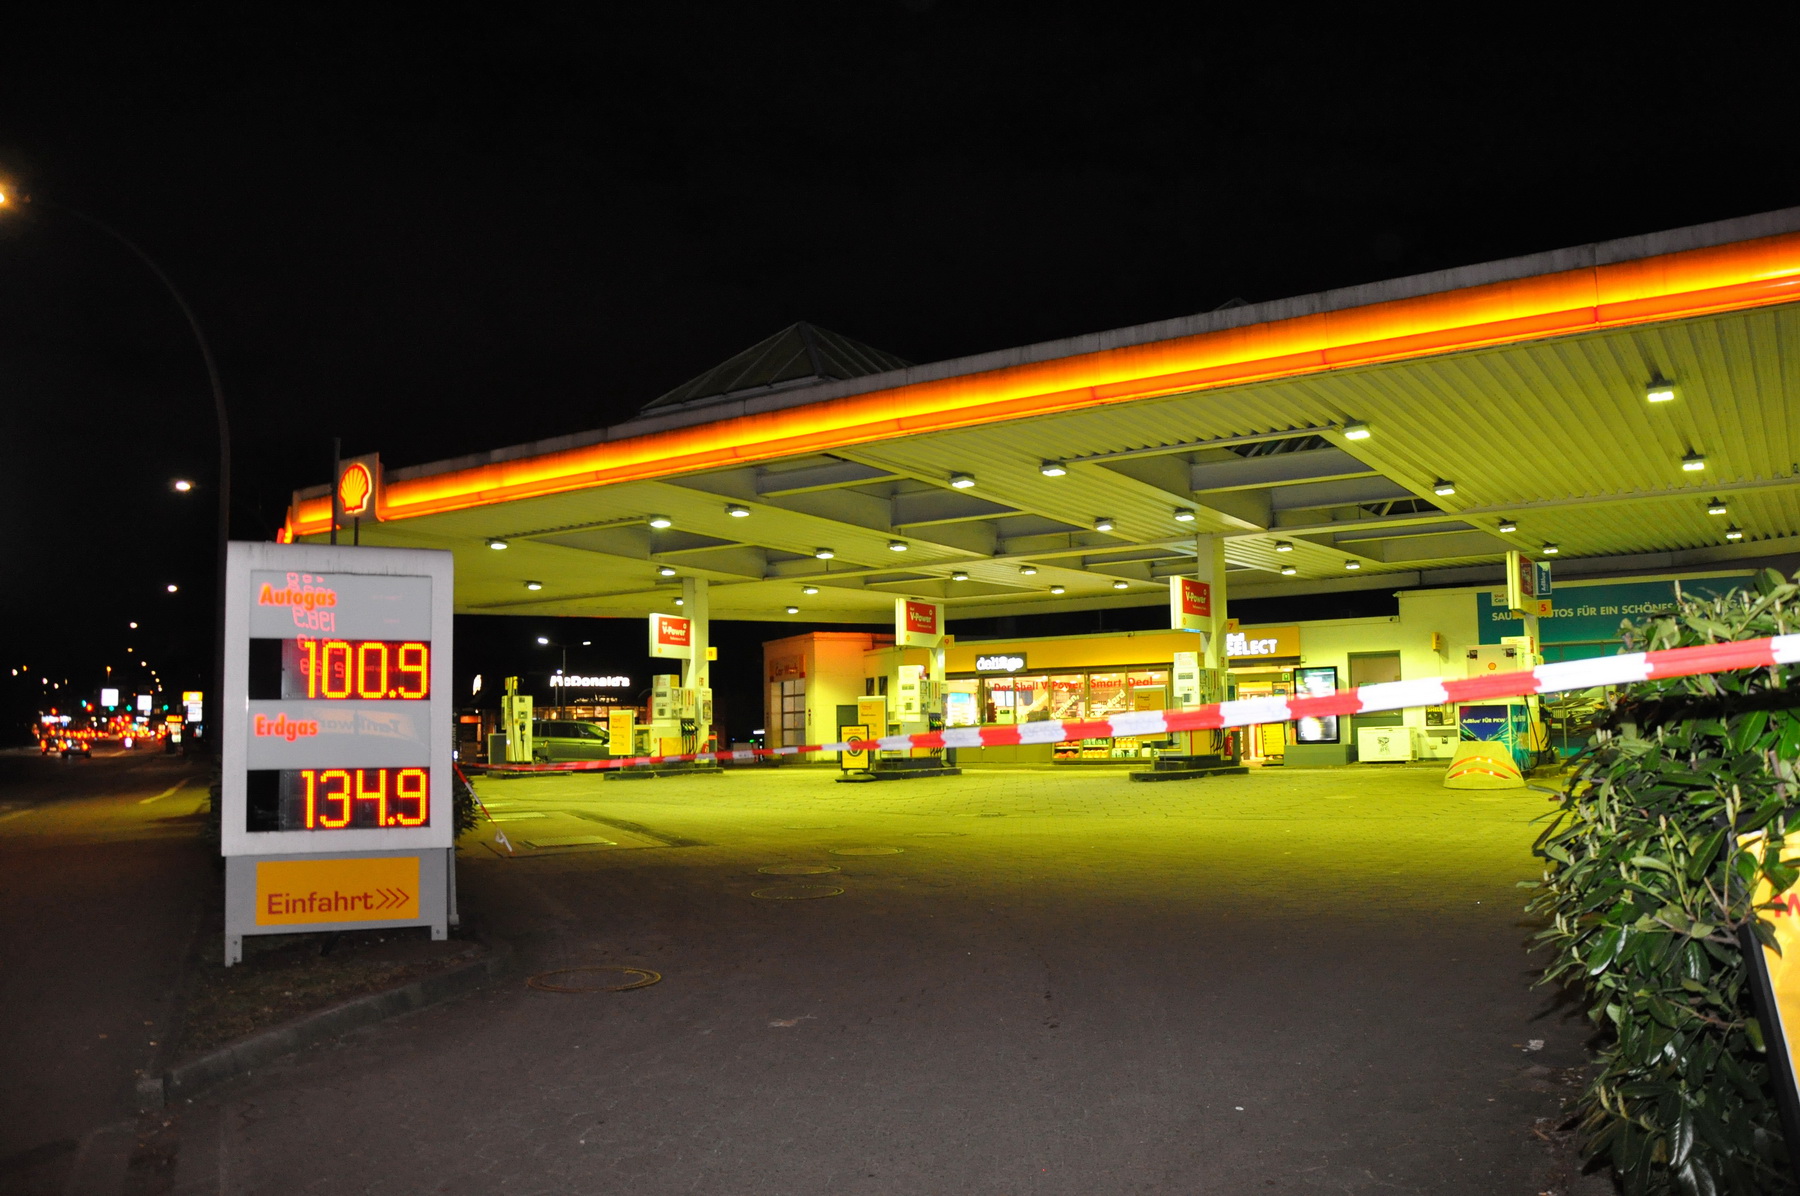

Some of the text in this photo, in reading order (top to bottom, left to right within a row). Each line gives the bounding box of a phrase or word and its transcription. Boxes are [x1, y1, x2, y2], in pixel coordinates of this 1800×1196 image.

[259, 583, 337, 611] Autogas
[1185, 590, 1207, 604] V-Power
[1541, 603, 1547, 612] 5
[1577, 605, 1597, 617] FÜR
[1601, 606, 1619, 615] EIN
[909, 611, 932, 623] V-Power
[662, 625, 686, 636] V-Power
[1229, 622, 1234, 630] 7
[1226, 638, 1278, 657] SELECT
[304, 641, 428, 699] 100.9
[550, 675, 631, 688] McDonald's
[994, 676, 1153, 692] Der Shell V-Power Smart Deal
[255, 713, 318, 741] Erdgas
[1482, 716, 1492, 724] FÜR
[301, 768, 427, 829] 134.9
[267, 890, 375, 915] Einfahrt
